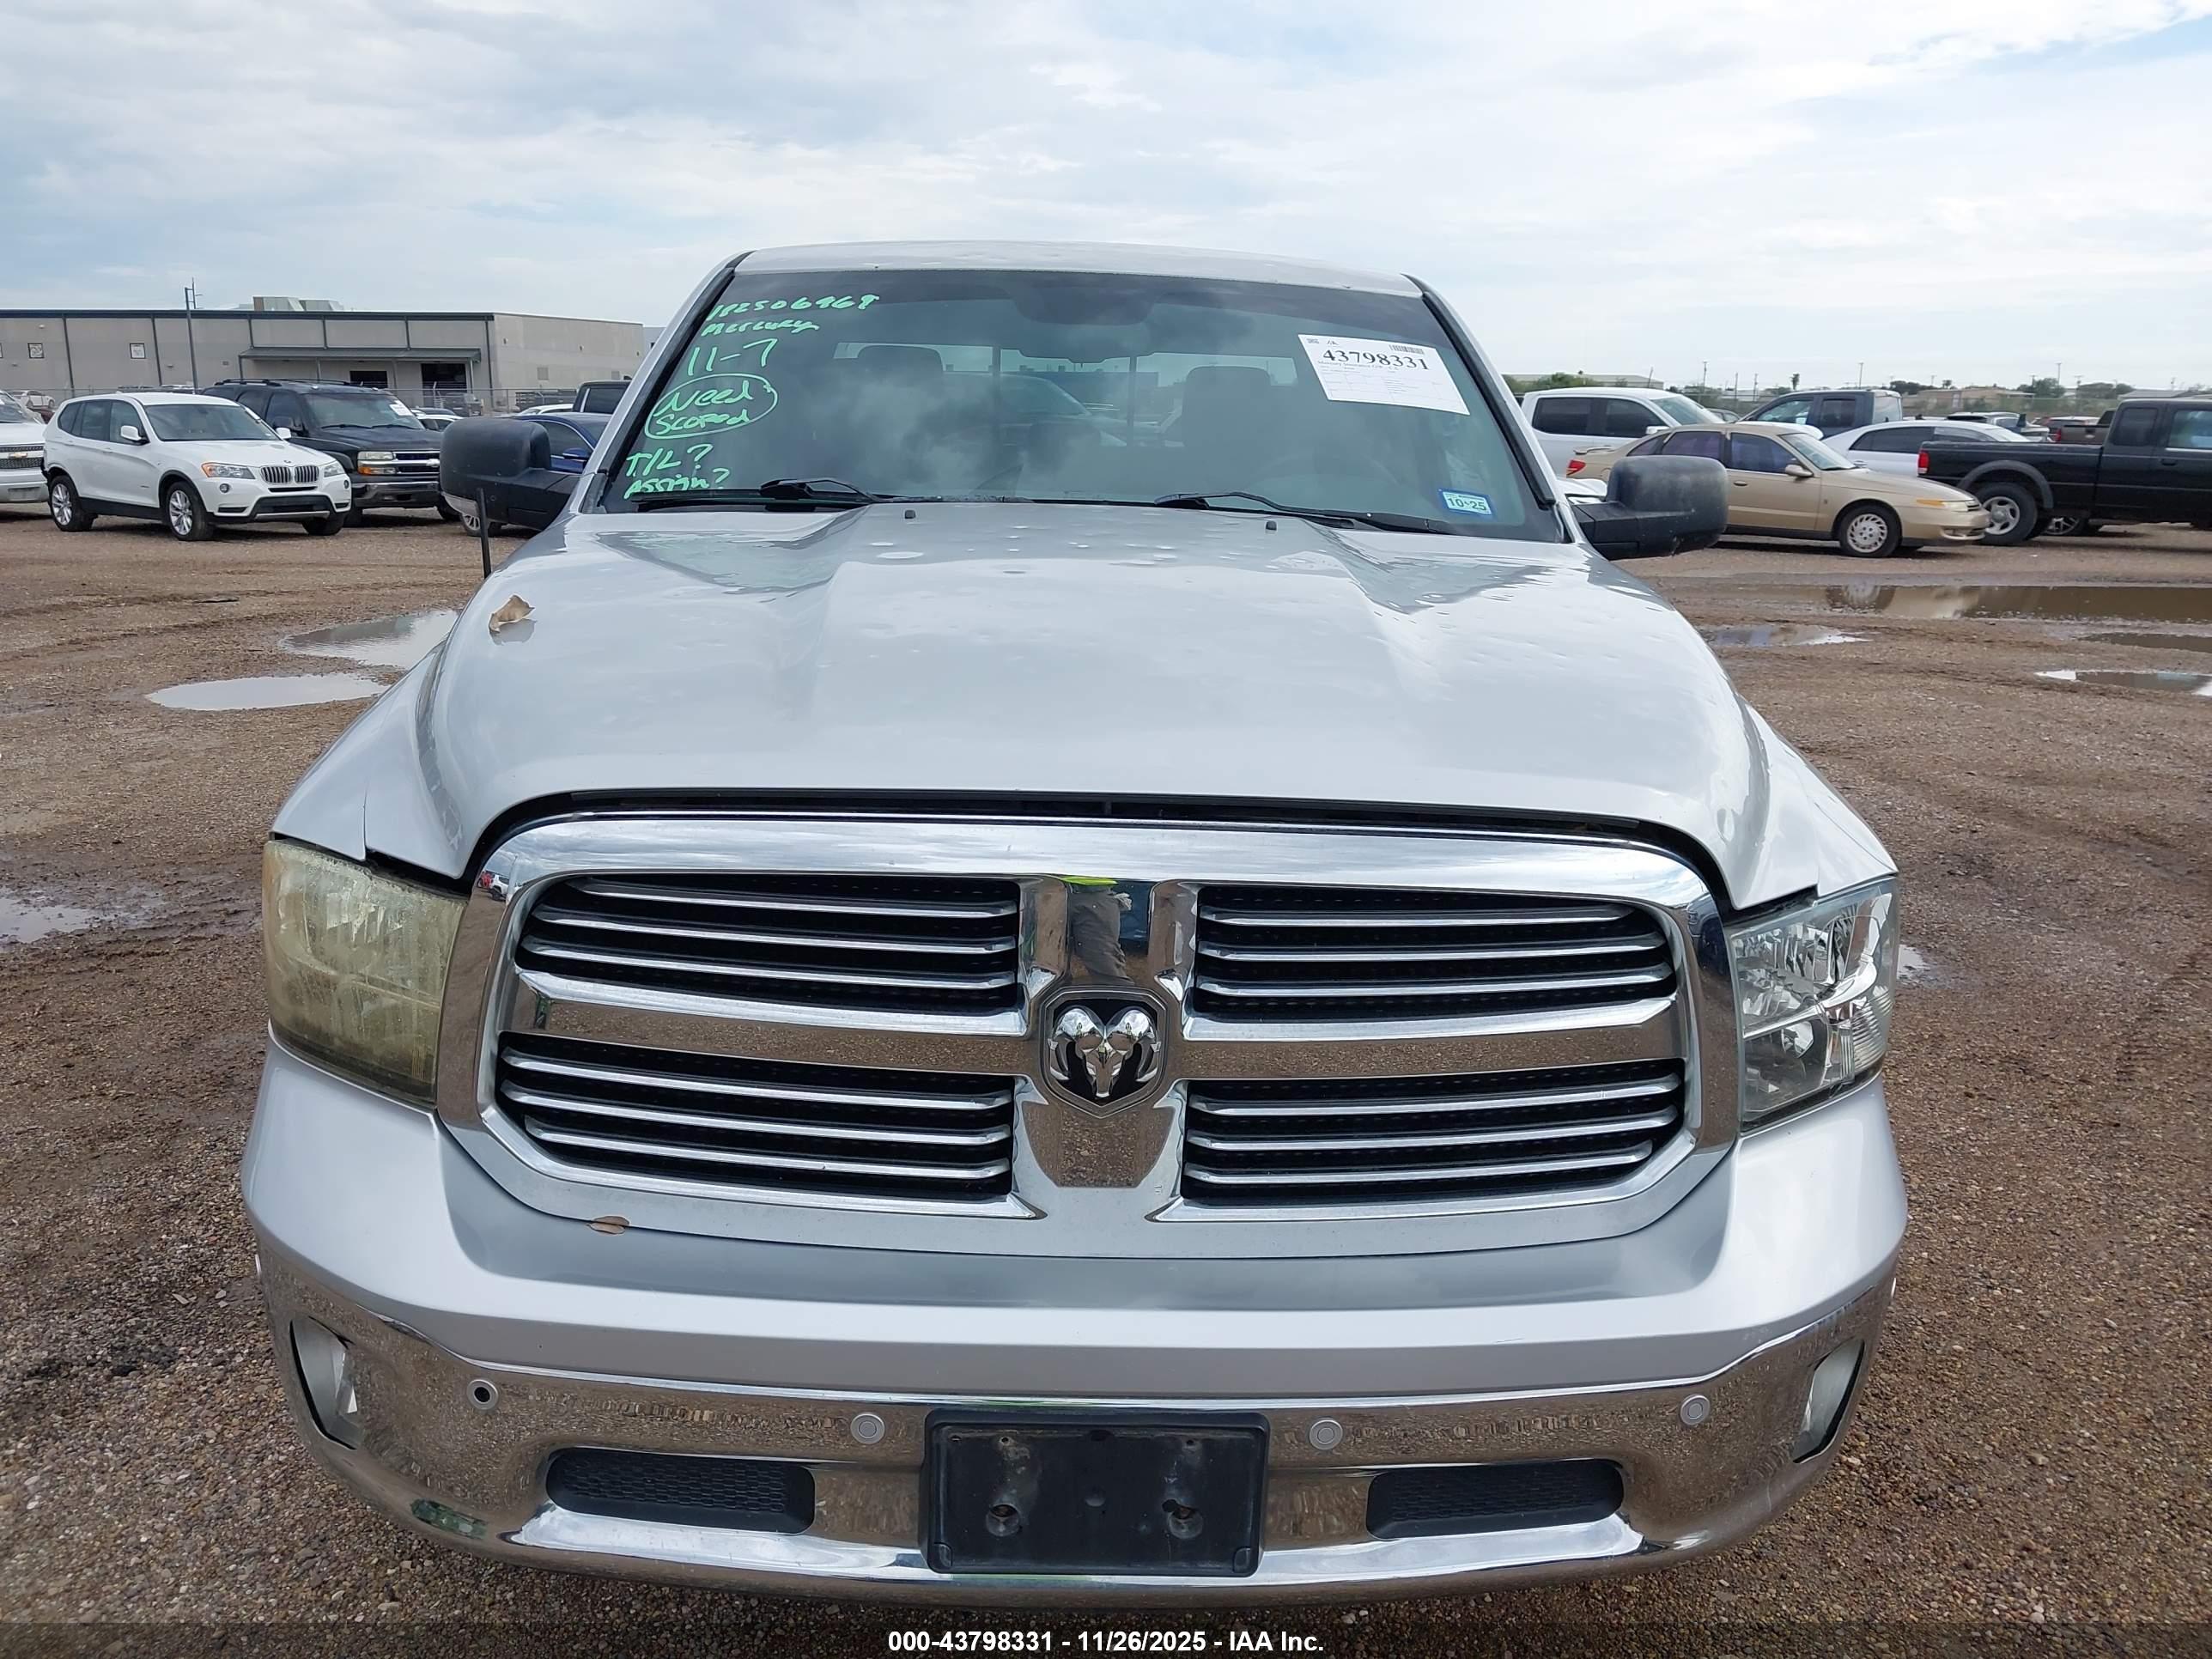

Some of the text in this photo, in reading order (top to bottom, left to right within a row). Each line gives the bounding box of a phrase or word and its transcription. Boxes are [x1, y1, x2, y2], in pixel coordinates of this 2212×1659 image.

[687, 339, 778, 376] 11-7
[1322, 349, 1430, 371] 43798331
[653, 380, 753, 416] Need
